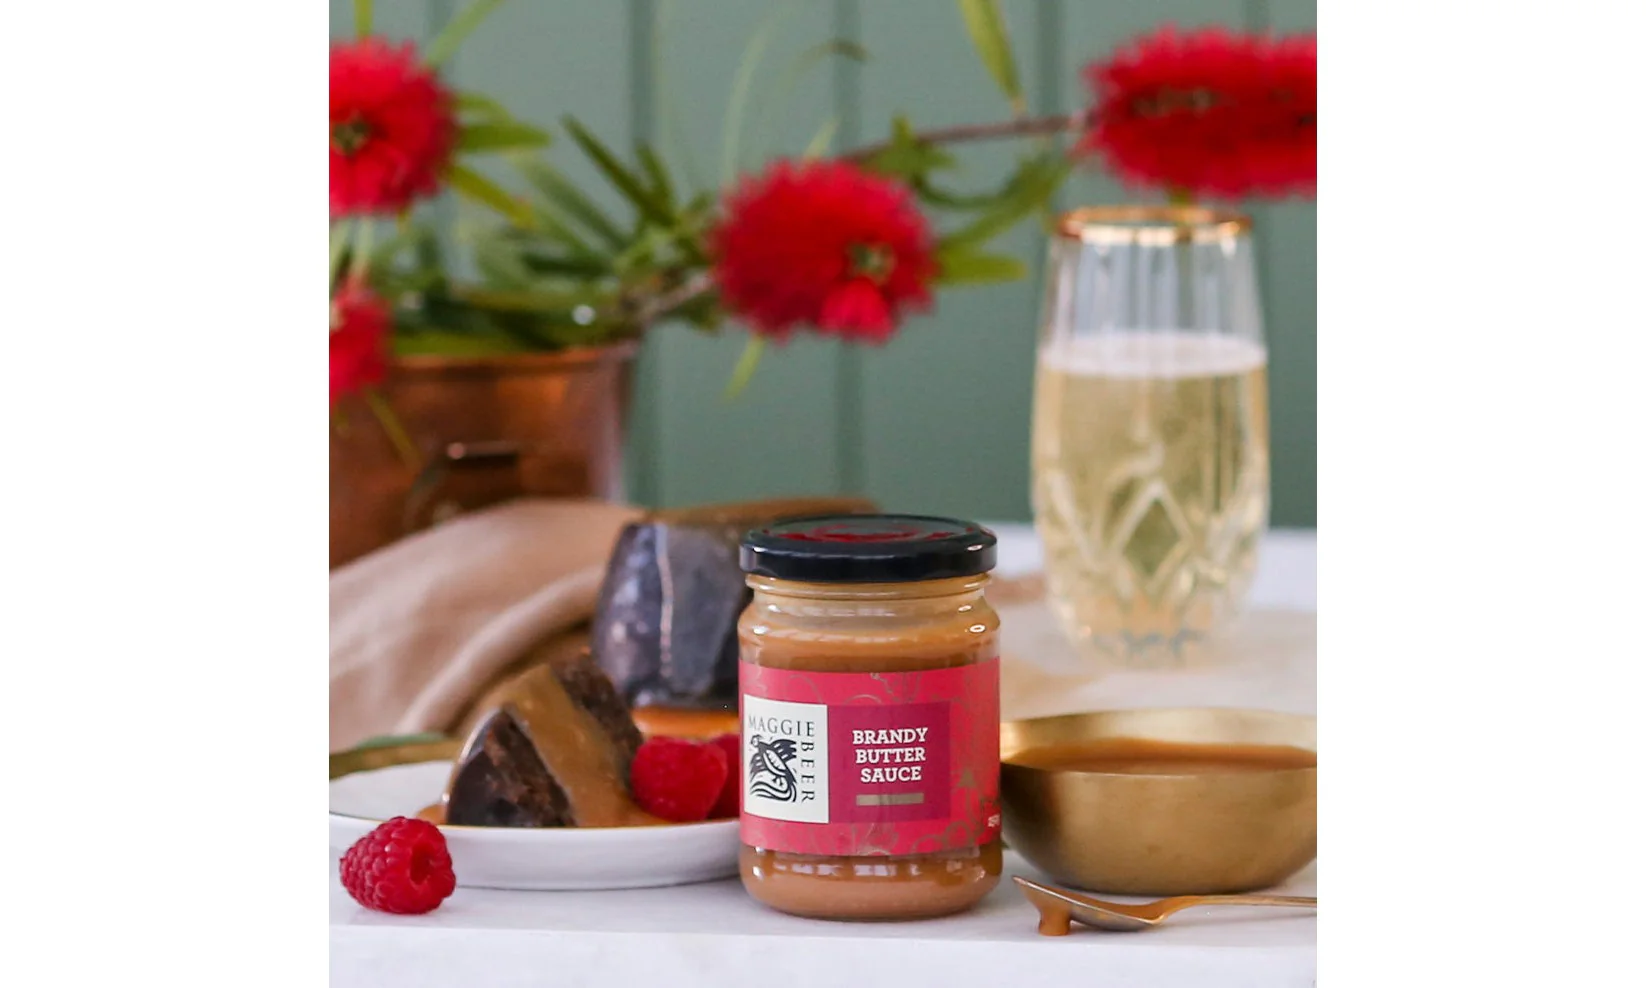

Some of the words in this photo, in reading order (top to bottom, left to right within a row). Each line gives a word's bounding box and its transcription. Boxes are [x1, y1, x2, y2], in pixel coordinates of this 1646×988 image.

[748, 715, 815, 737] MAGGIE
[852, 727, 928, 745] BRANDY
[855, 747, 926, 764] BUTTER
[801, 741, 815, 803] BEER
[860, 766, 922, 783] SAUCE
